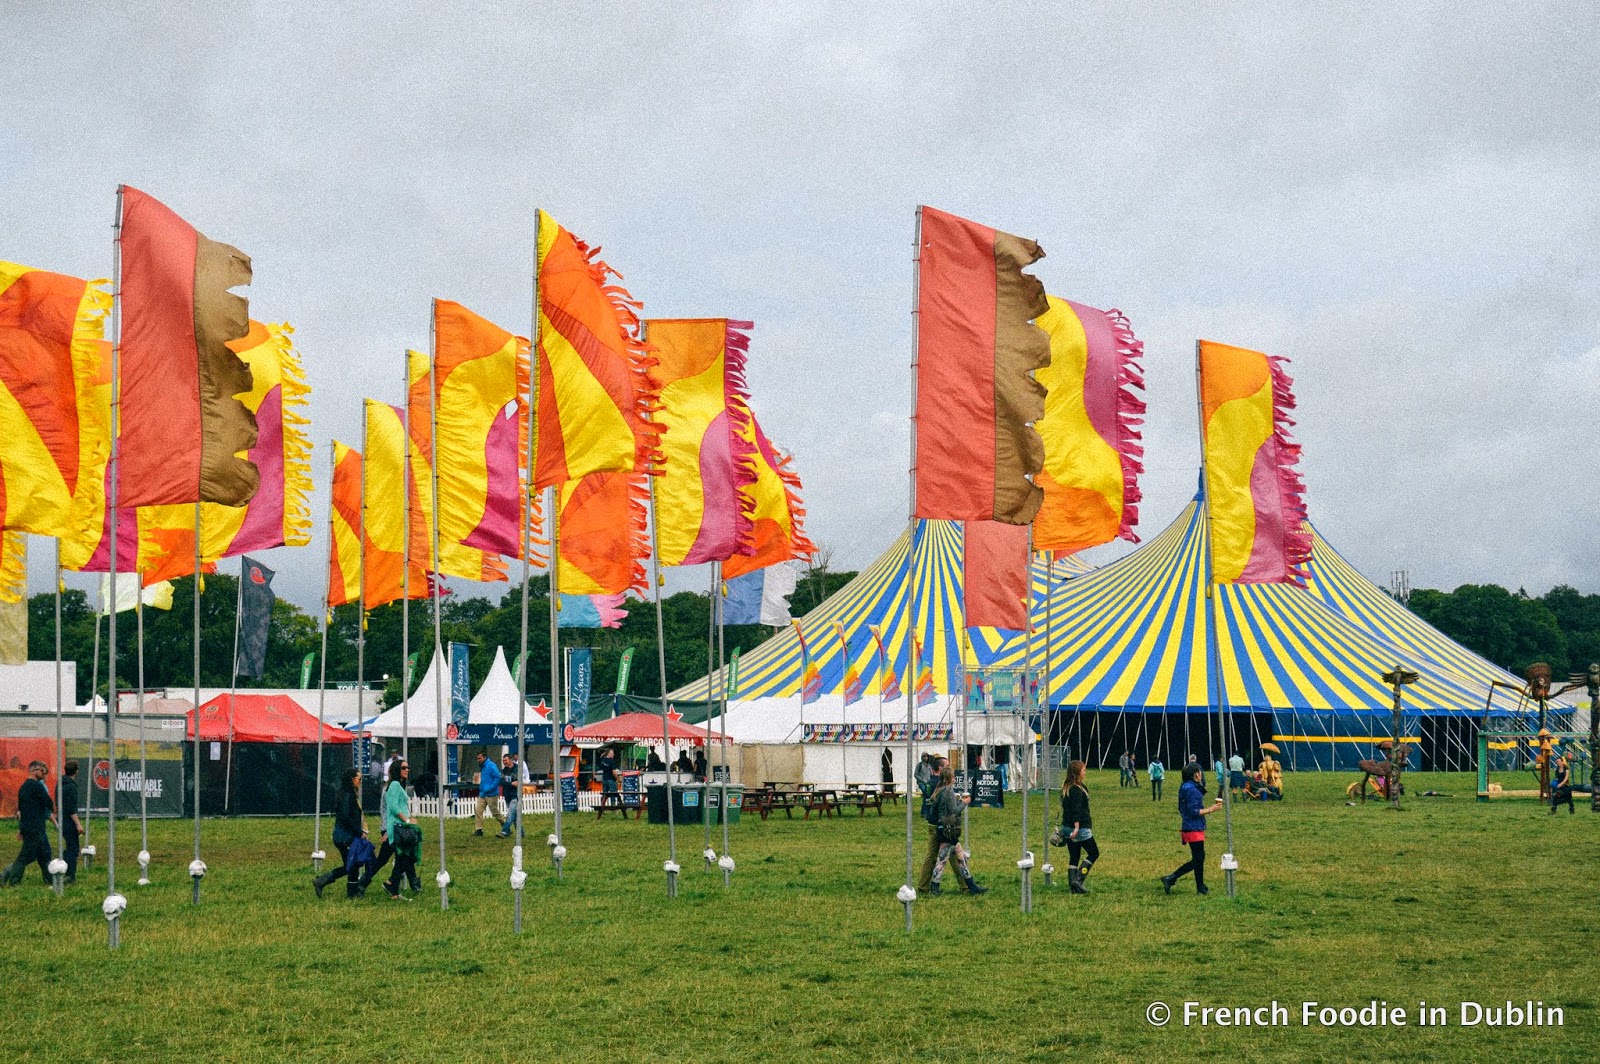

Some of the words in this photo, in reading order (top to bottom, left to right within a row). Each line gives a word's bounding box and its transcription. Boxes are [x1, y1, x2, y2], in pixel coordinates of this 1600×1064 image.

[492, 726, 513, 740] Kinara
[633, 737, 672, 747] CHARCOL
[674, 738, 696, 748] GRILL
[115, 779, 163, 792] UNTAMABLE
